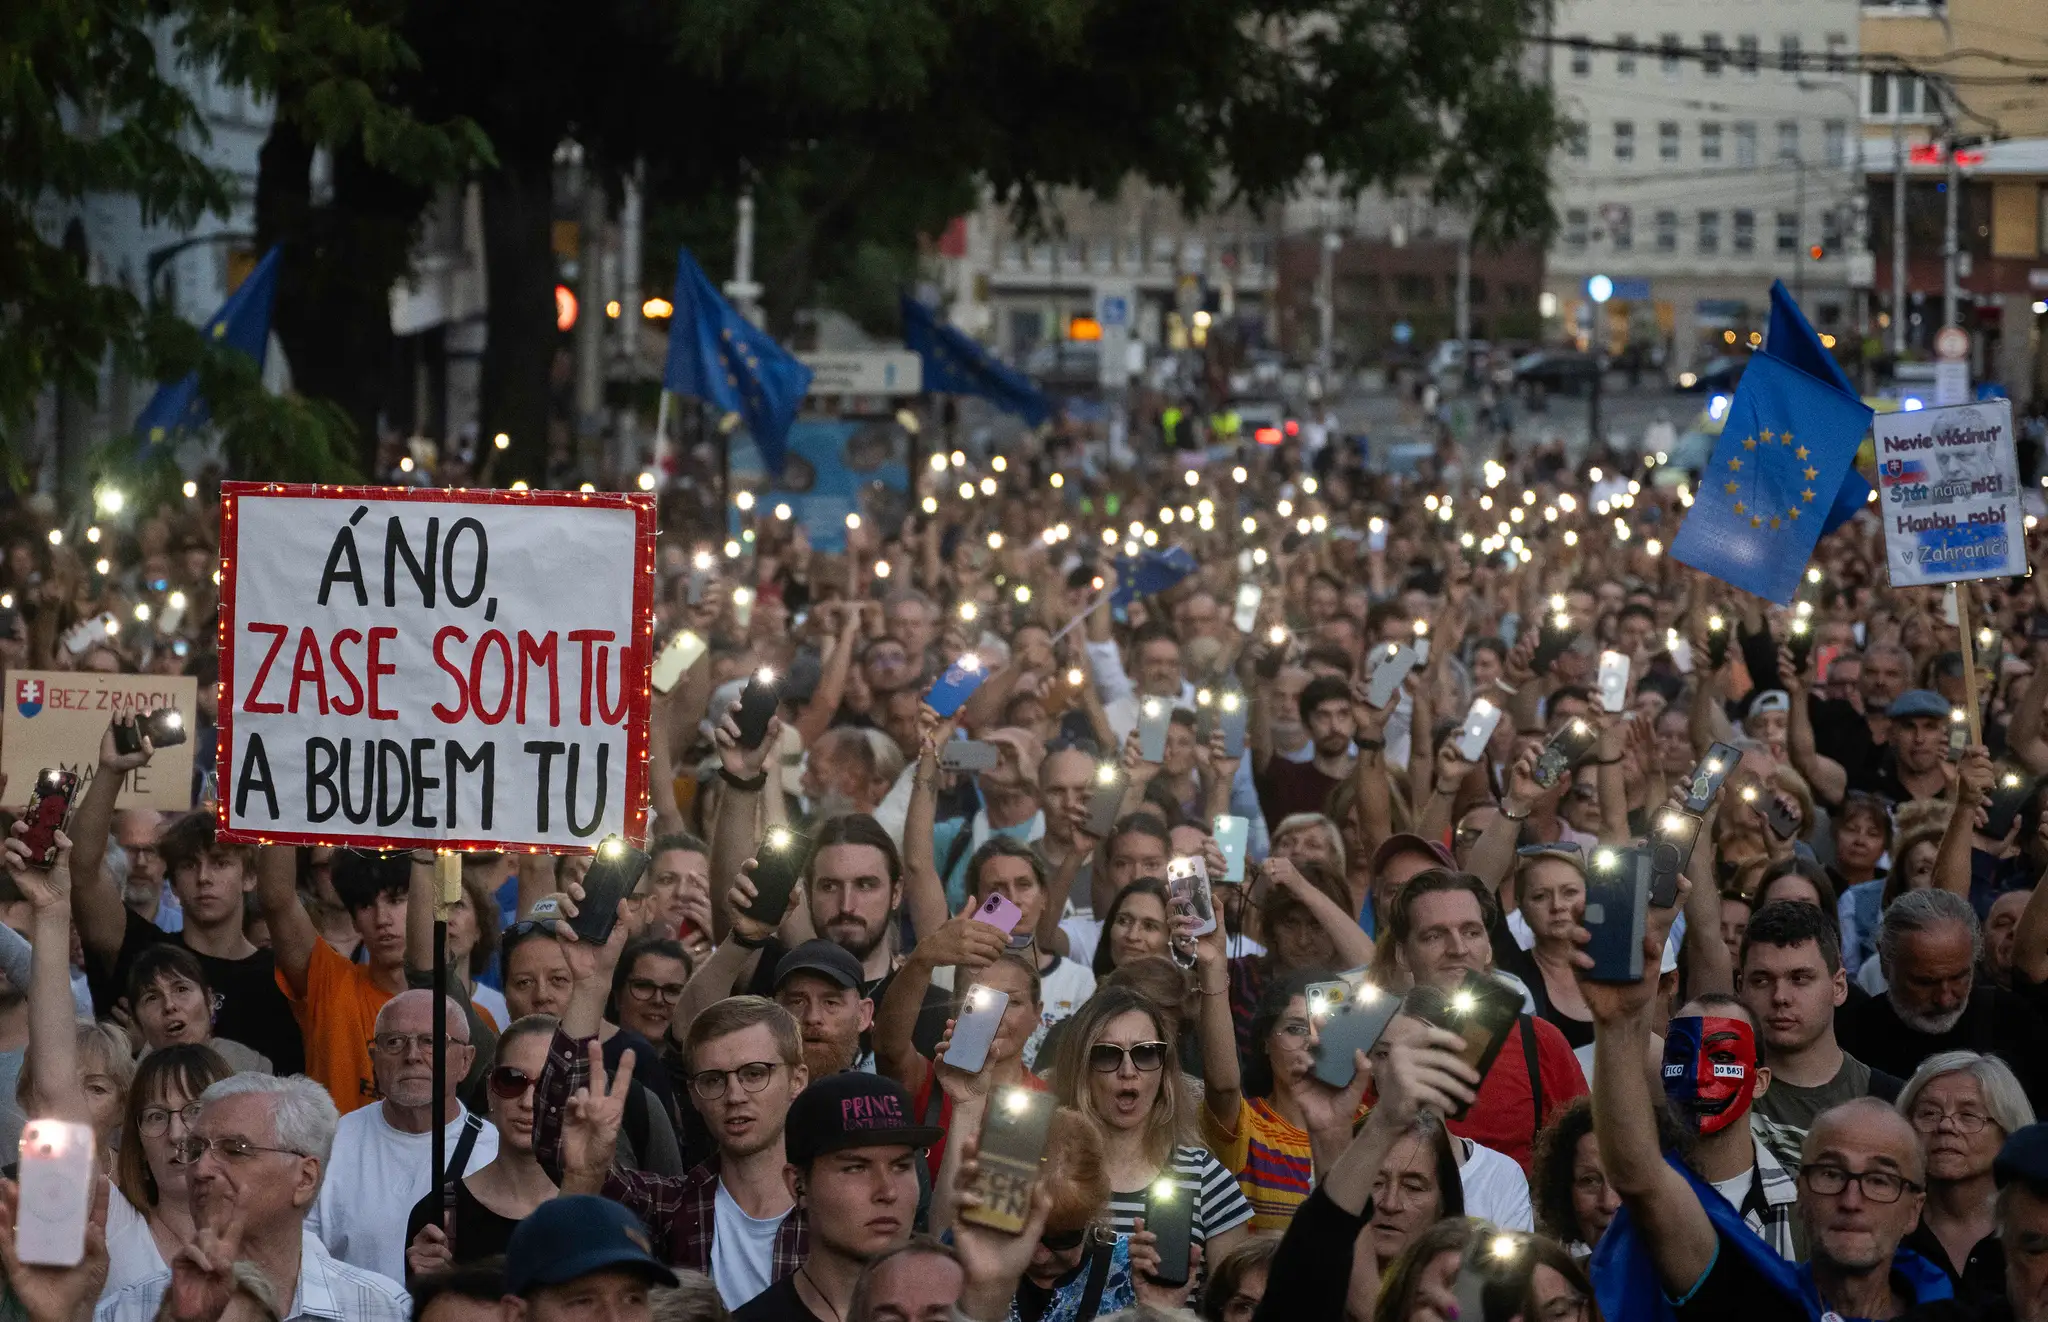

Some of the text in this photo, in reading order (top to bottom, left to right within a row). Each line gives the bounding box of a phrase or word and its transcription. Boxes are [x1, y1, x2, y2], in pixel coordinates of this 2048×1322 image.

[1884, 433, 1933, 453] Nevie
[1932, 479, 1968, 498] nám
[1897, 503, 2007, 534] Hanbu robí
[317, 505, 497, 622] ÁNO,
[1917, 537, 2009, 565] Zahraničí
[242, 622, 399, 721] ZASE
[431, 625, 561, 728] SOM
[49, 687, 91, 711] BEZ
[235, 732, 610, 838] A BUDEM TU
[1666, 1066, 1683, 1075] FICO
[1715, 1066, 1724, 1074] DO
[841, 1095, 902, 1120] PRINCE
